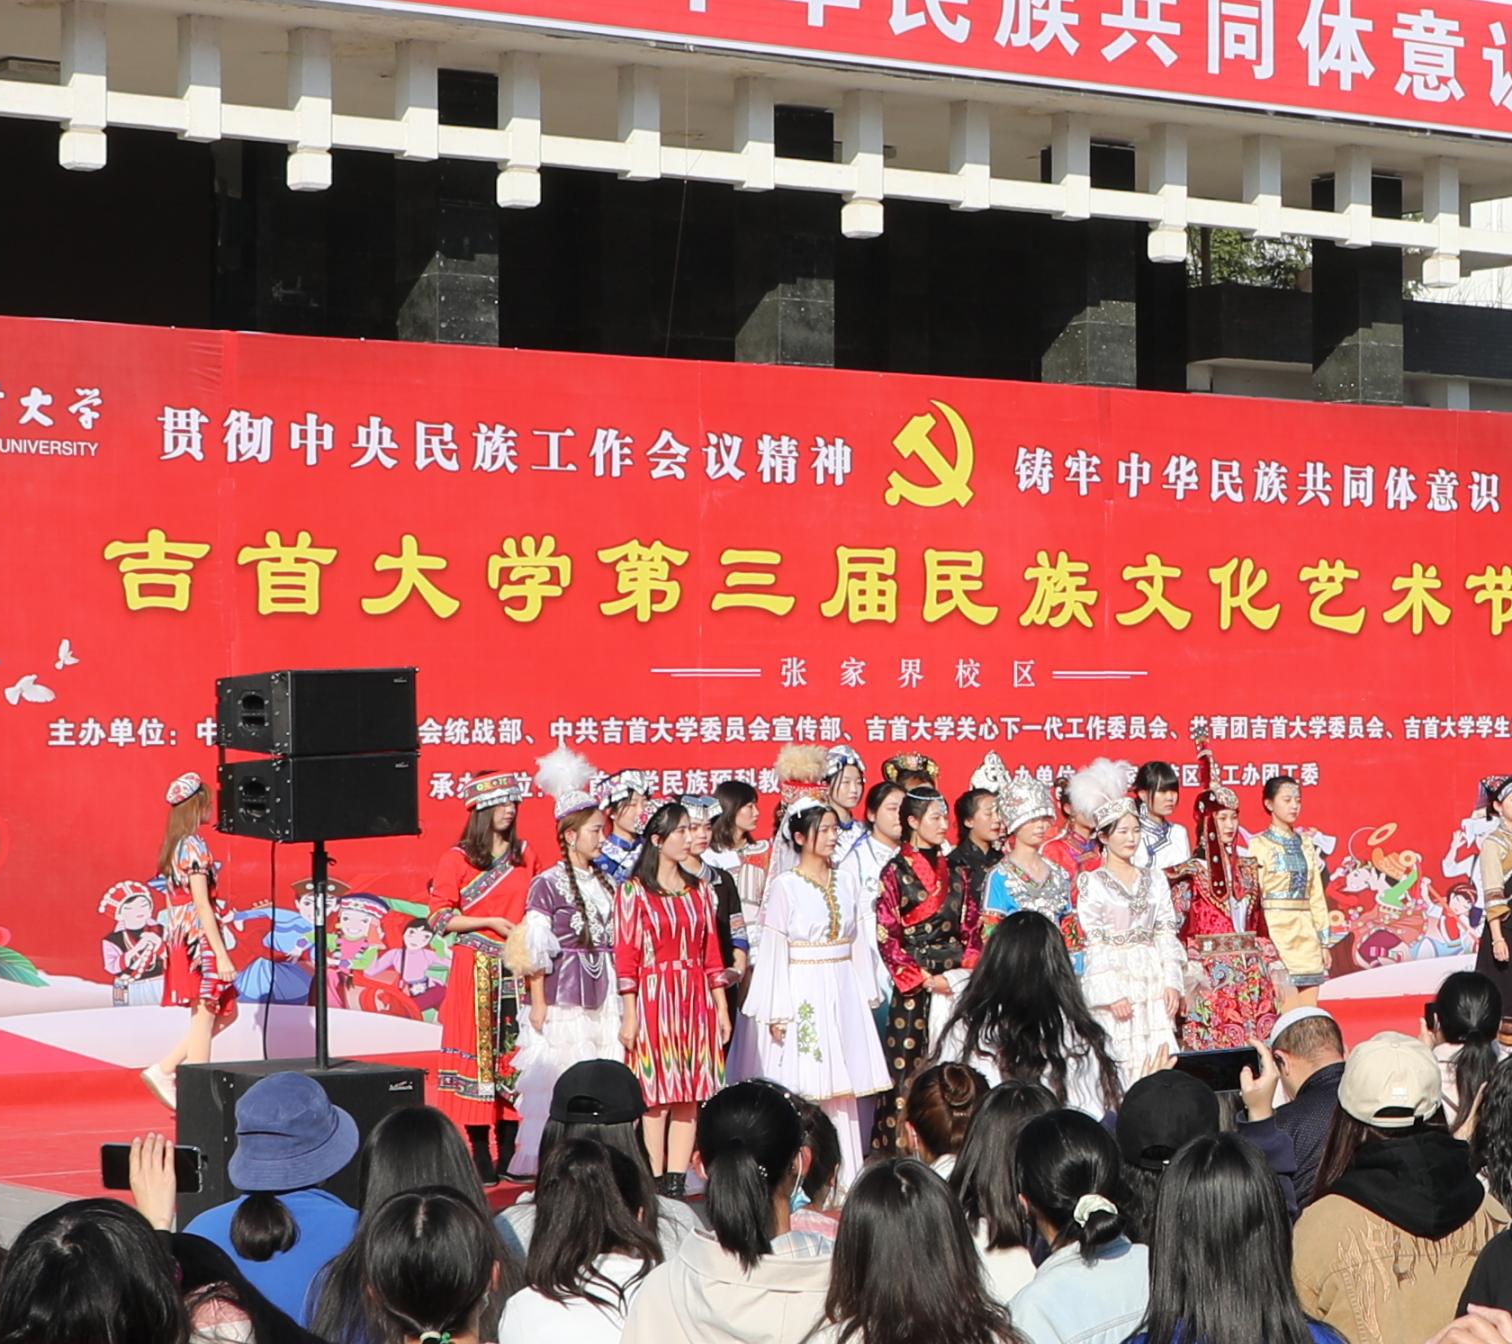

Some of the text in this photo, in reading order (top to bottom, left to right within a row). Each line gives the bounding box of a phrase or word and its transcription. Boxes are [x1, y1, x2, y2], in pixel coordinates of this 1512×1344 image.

[159, 407, 1501, 514] 贯彻中央民族工作会议精神 铸牢中华民族共同体意识
[781, 657, 1036, 688] 张家界校区
